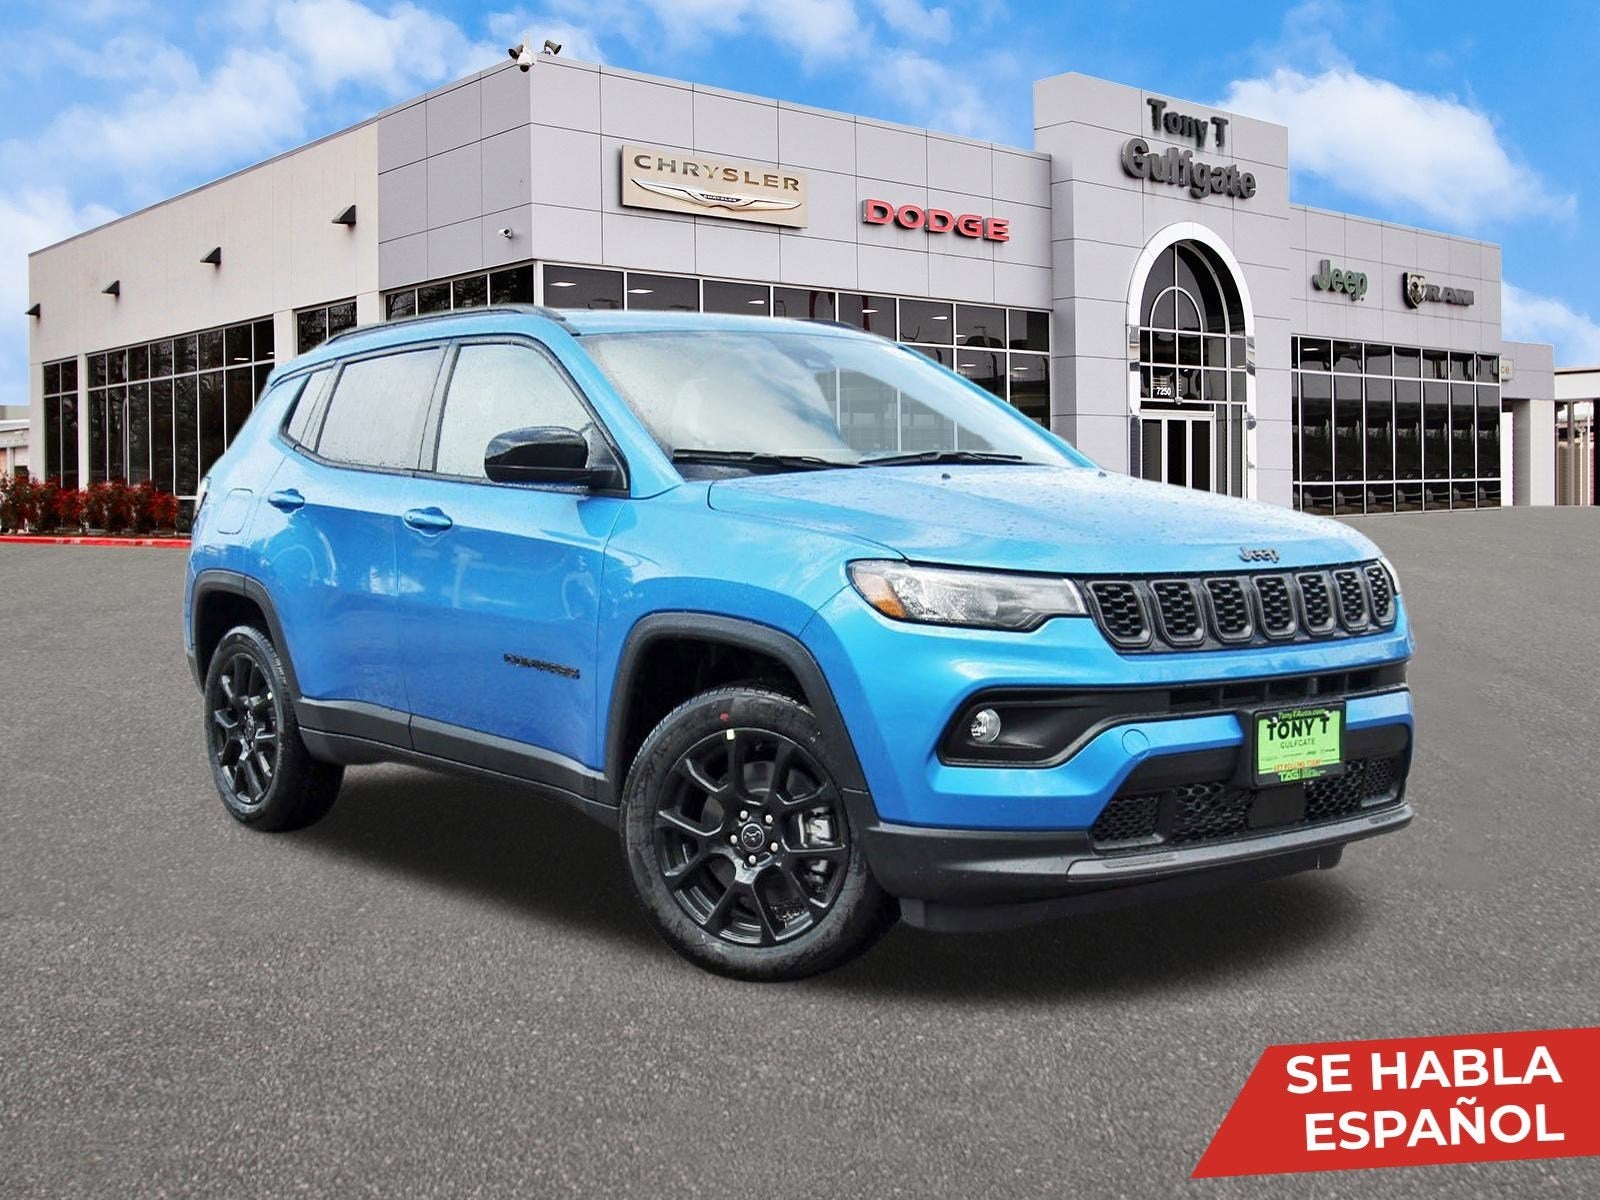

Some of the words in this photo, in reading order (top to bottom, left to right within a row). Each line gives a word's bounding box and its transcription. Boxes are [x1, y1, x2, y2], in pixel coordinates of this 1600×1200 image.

[1147, 98, 1207, 147] Tony
[1210, 117, 1229, 147] T
[633, 154, 801, 192] CHRYSLER
[1121, 138, 1256, 199] Gulfgate
[862, 198, 1010, 242] DODGE
[1312, 259, 1368, 302] Jeep
[1425, 284, 1475, 306] RAM
[1156, 386, 1171, 395] 7250
[1239, 547, 1279, 564] Jeep
[1267, 719, 1314, 741] TONY
[1320, 717, 1329, 733] T
